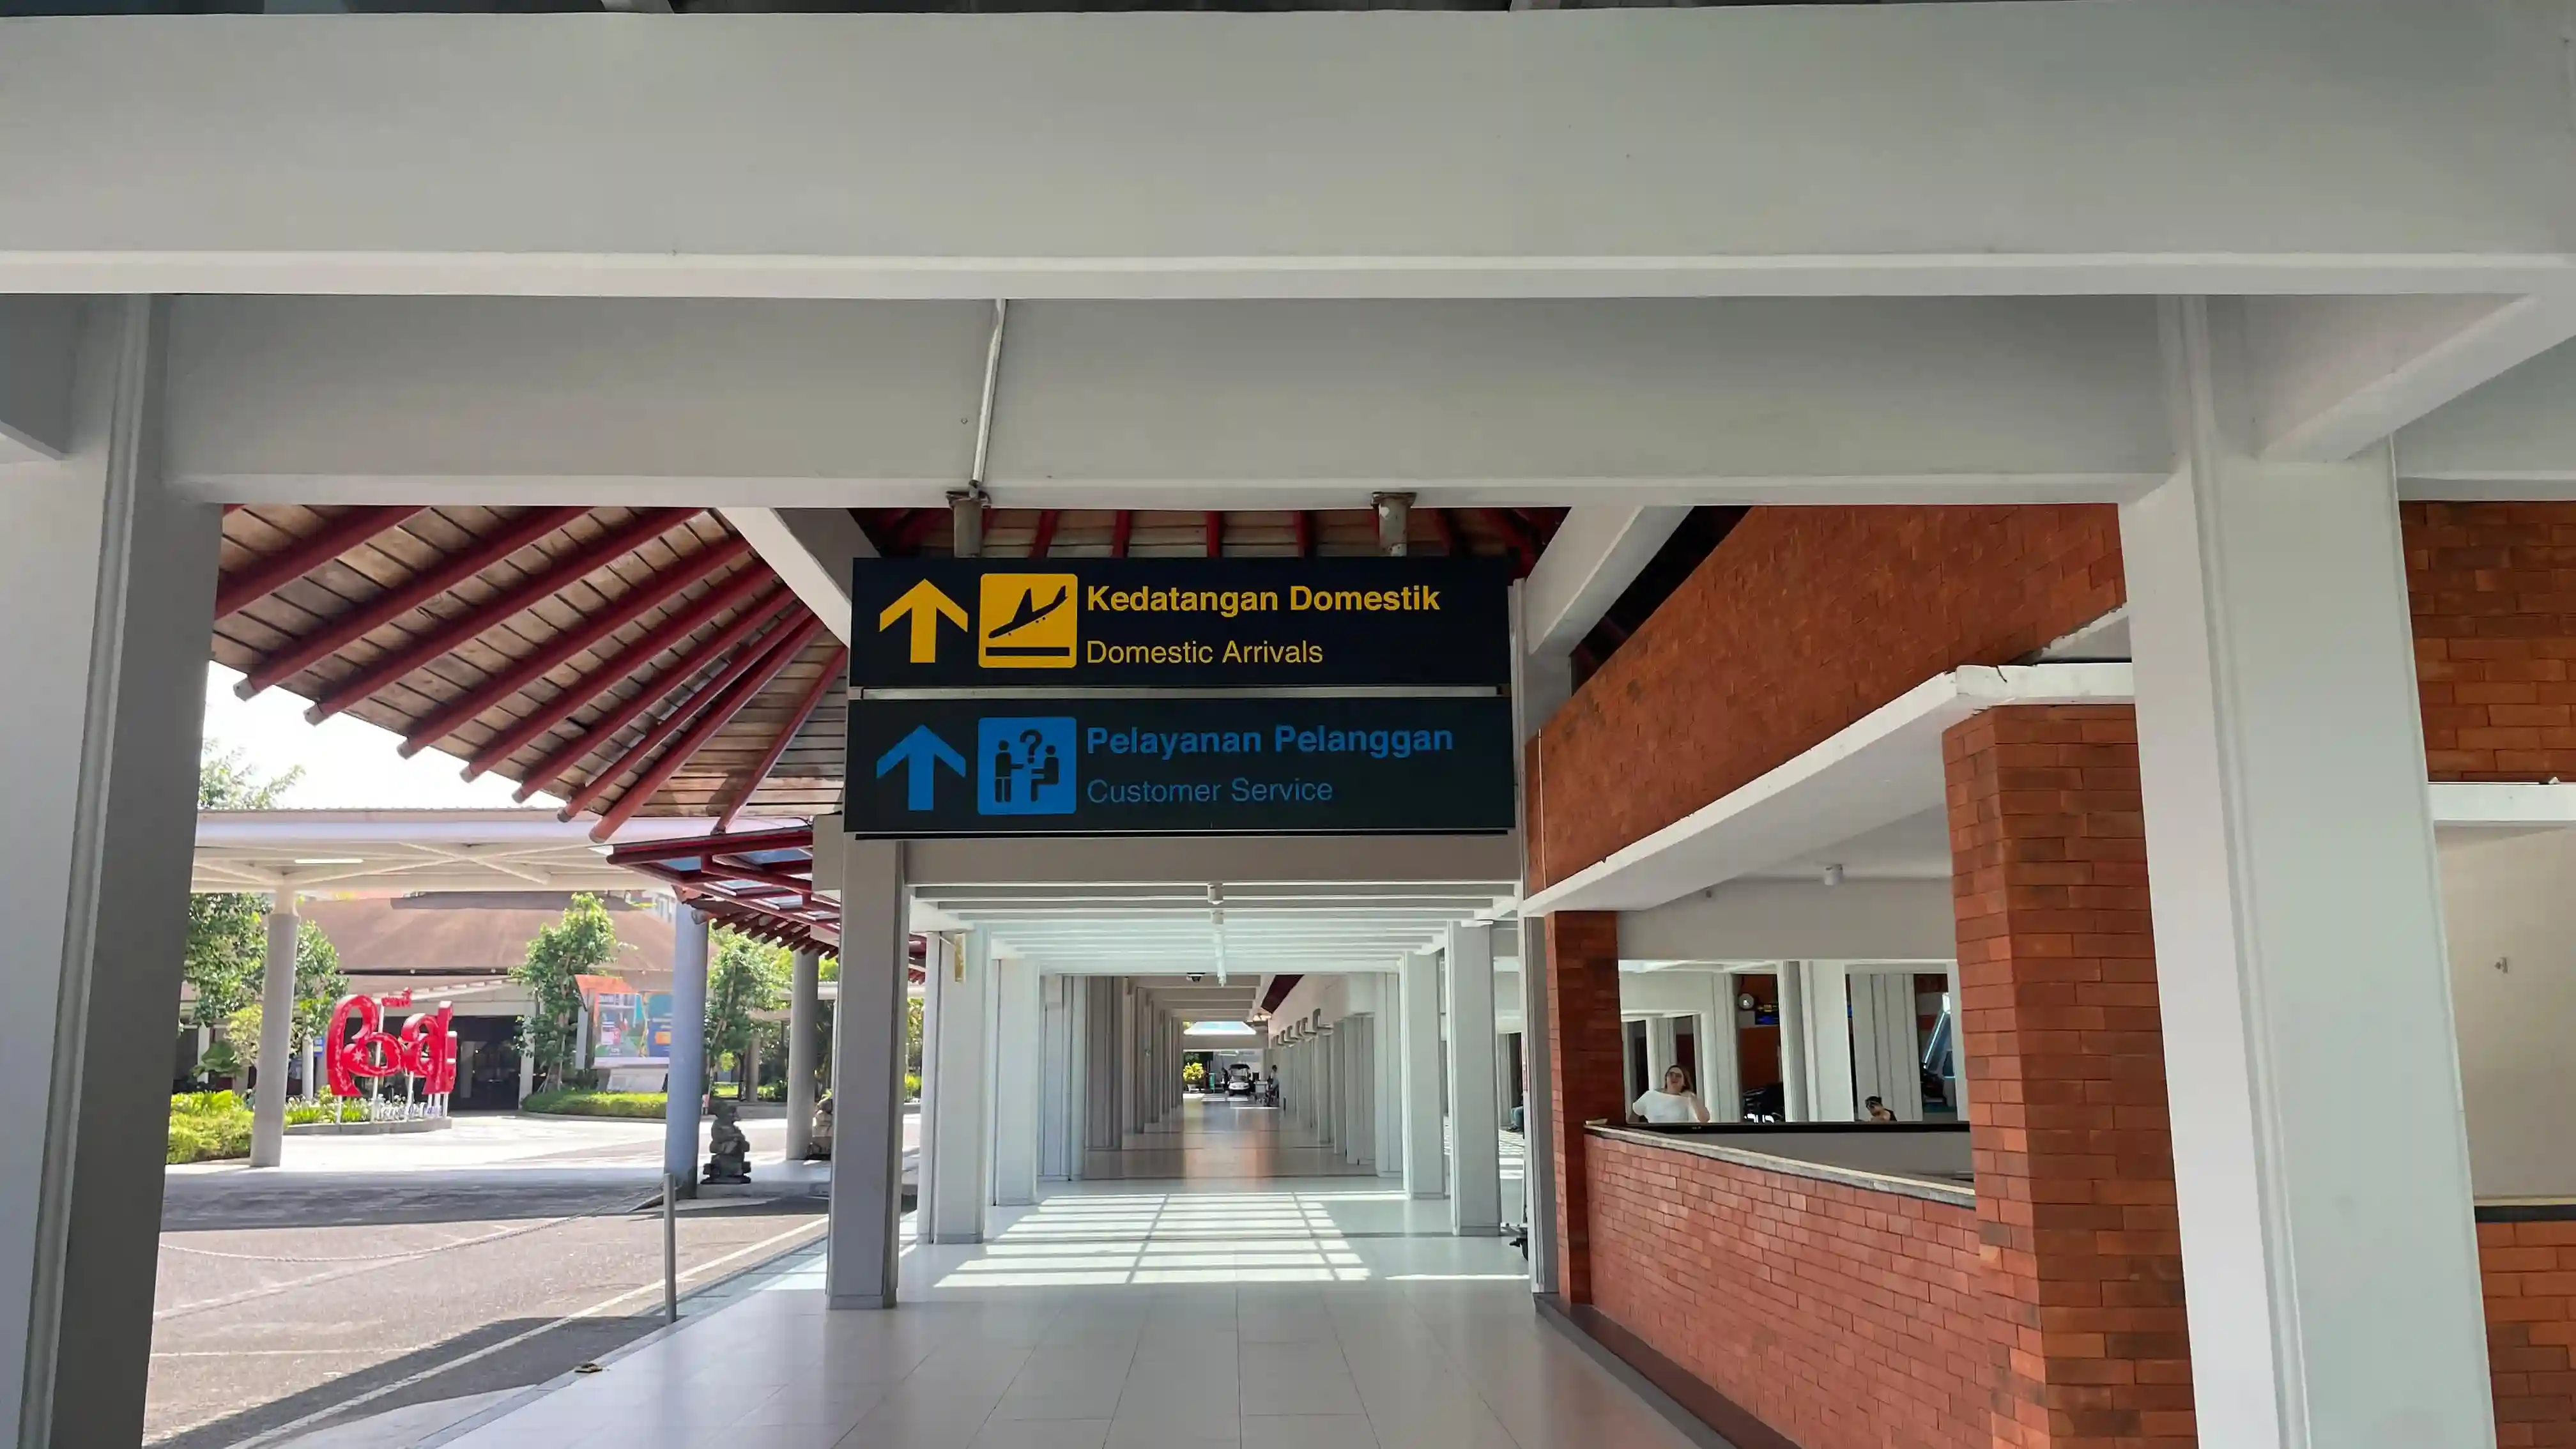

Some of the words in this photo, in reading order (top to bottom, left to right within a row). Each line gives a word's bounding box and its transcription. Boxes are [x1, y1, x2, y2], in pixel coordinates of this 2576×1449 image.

[1087, 586, 1278, 618] Kedatangan
[1290, 585, 1441, 611] Domestik
[1087, 641, 1212, 664] Domestic
[1223, 640, 1323, 663] Arrivals
[1087, 727, 1261, 760] Pelayanan
[1274, 725, 1453, 759] Pelanggan
[1087, 780, 1222, 804] Customer
[1230, 778, 1333, 802] Service
